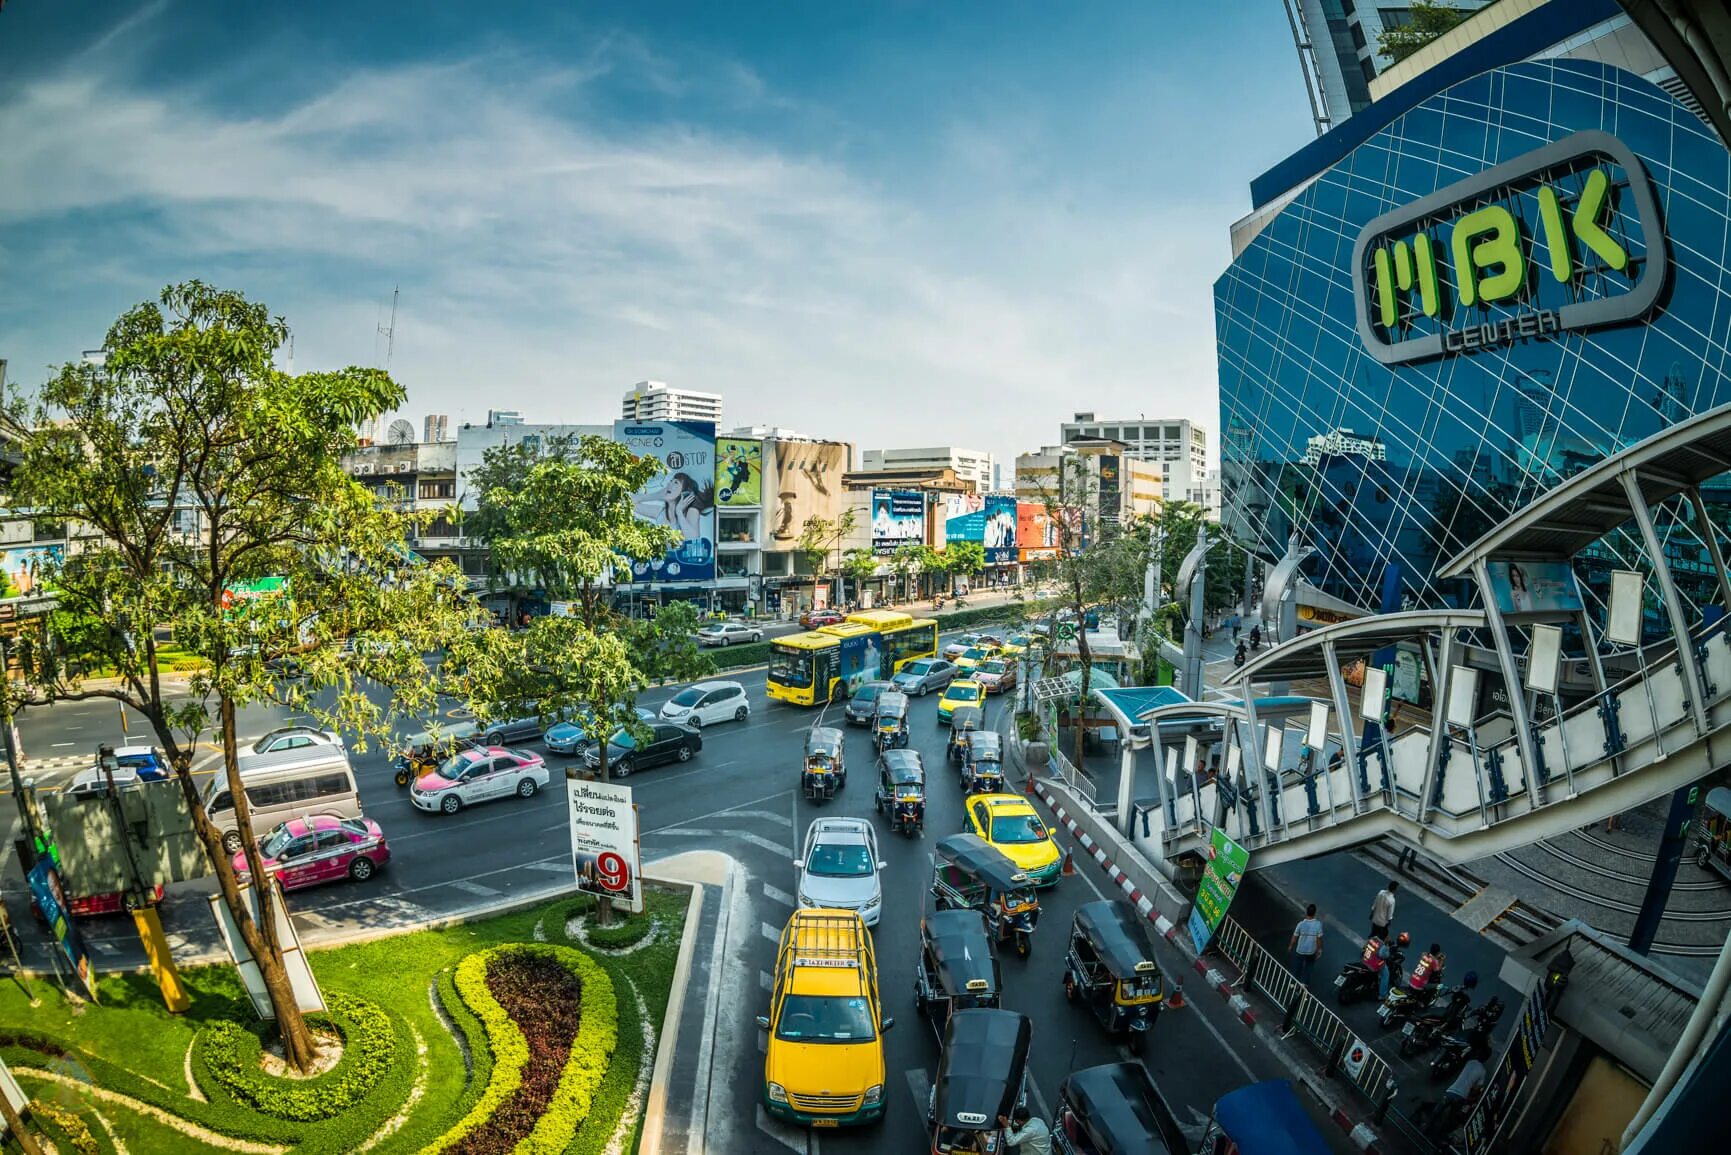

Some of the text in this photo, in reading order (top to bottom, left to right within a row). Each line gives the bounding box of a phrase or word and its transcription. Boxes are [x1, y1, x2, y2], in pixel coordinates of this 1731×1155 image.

[1374, 169, 1629, 328] MBK
[1446, 309, 1558, 351] CENTER
[684, 452, 707, 465] STOP
[597, 851, 630, 892] 9
[1414, 963, 1426, 976] 28
